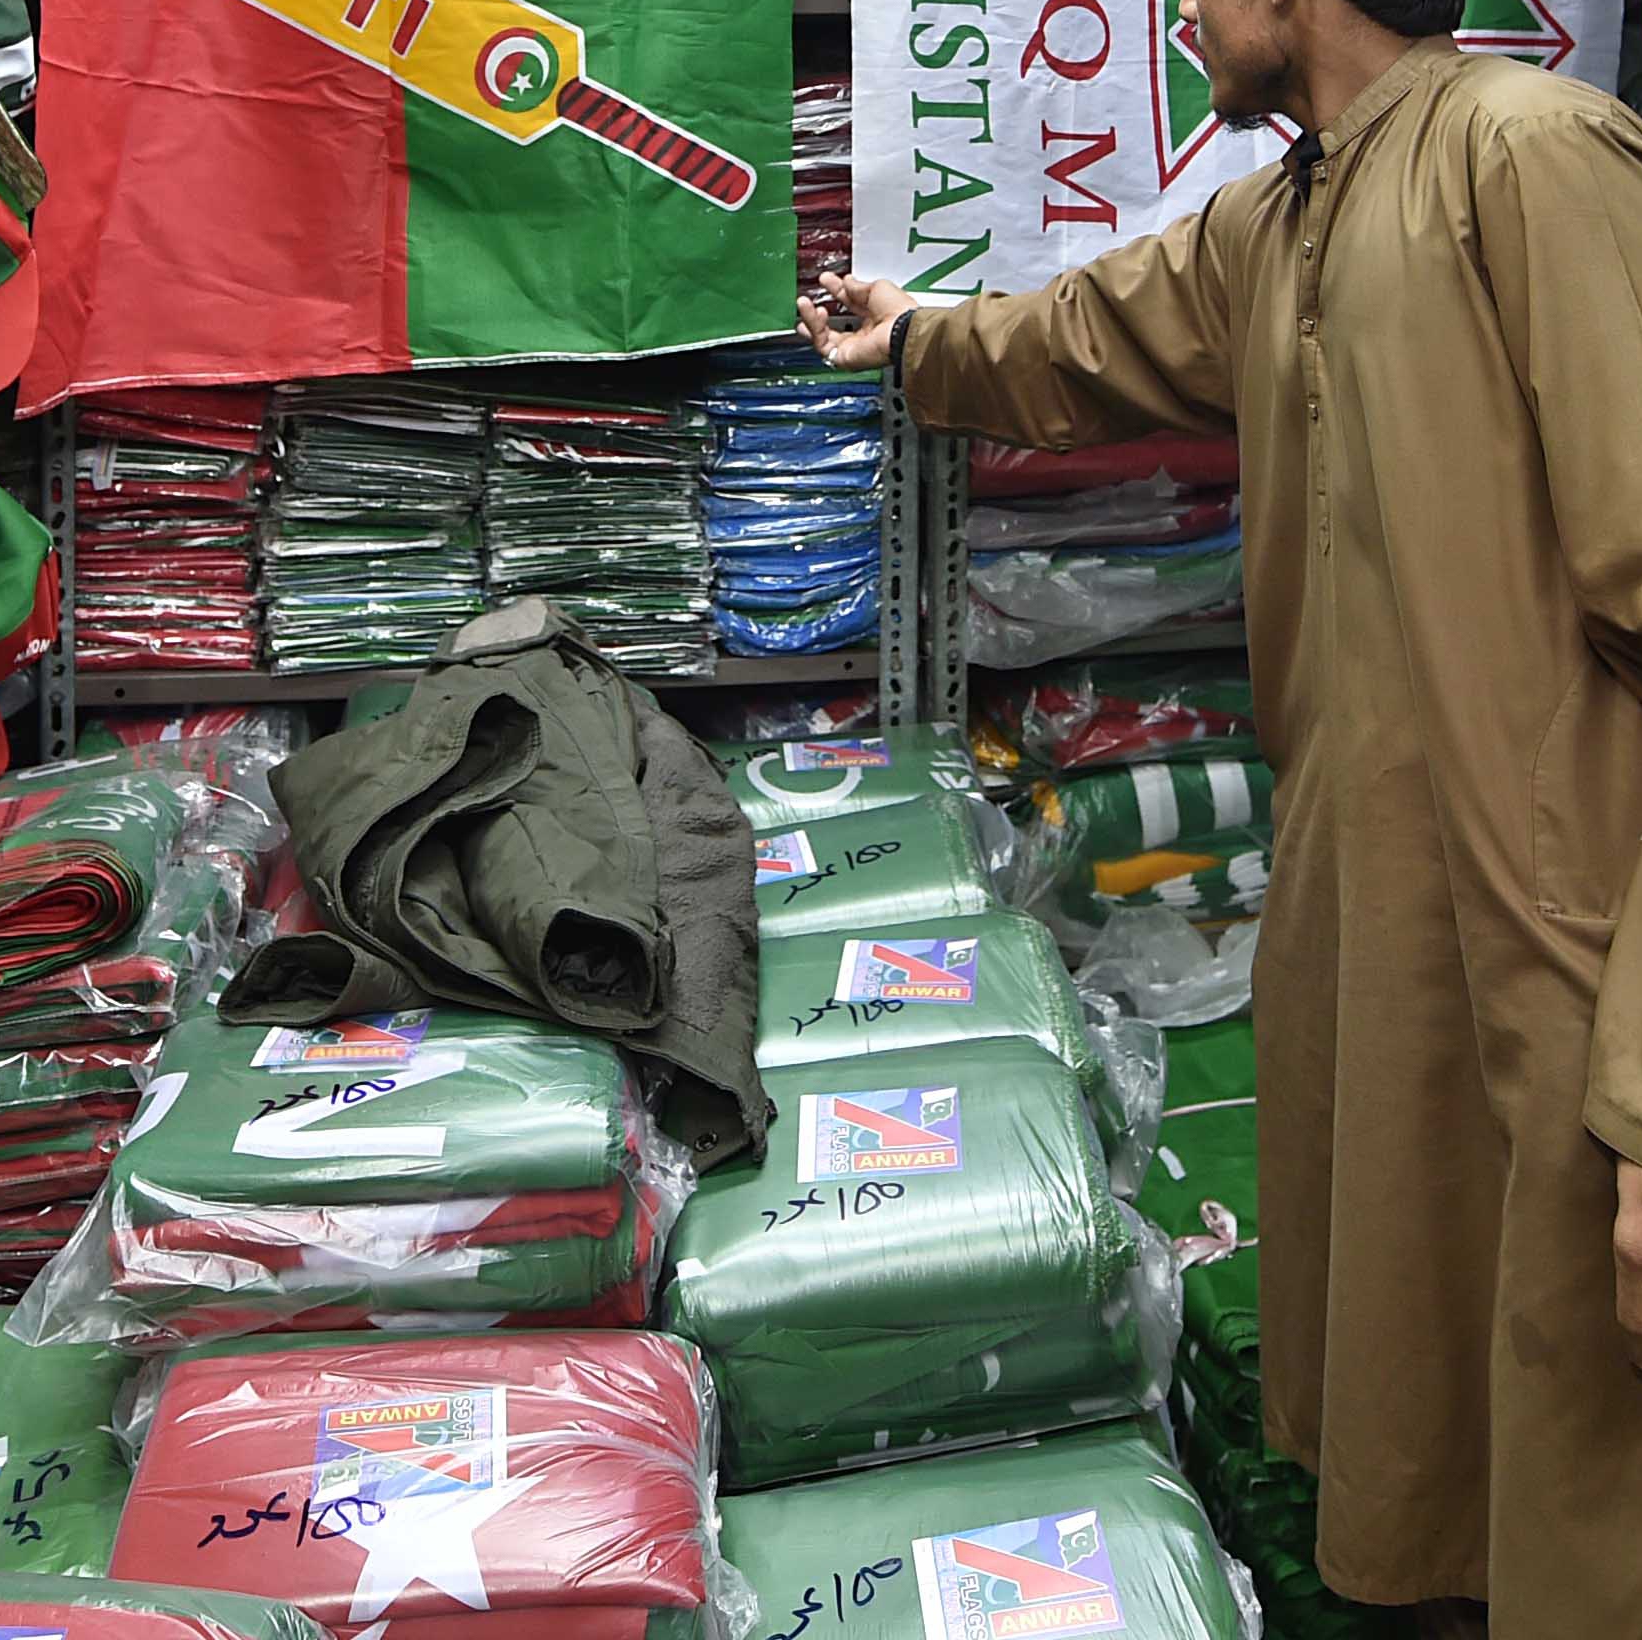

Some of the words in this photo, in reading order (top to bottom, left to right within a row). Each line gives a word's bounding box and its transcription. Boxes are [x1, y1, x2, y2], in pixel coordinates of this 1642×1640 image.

[886, 985, 963, 999] ANWAR
[831, 1124, 849, 1173] FLAGS
[859, 1150, 947, 1170] ANWAR
[339, 1401, 443, 1427] ANWAR
[453, 1396, 473, 1445] LAGS
[999, 1600, 1105, 1634] ANWAR
